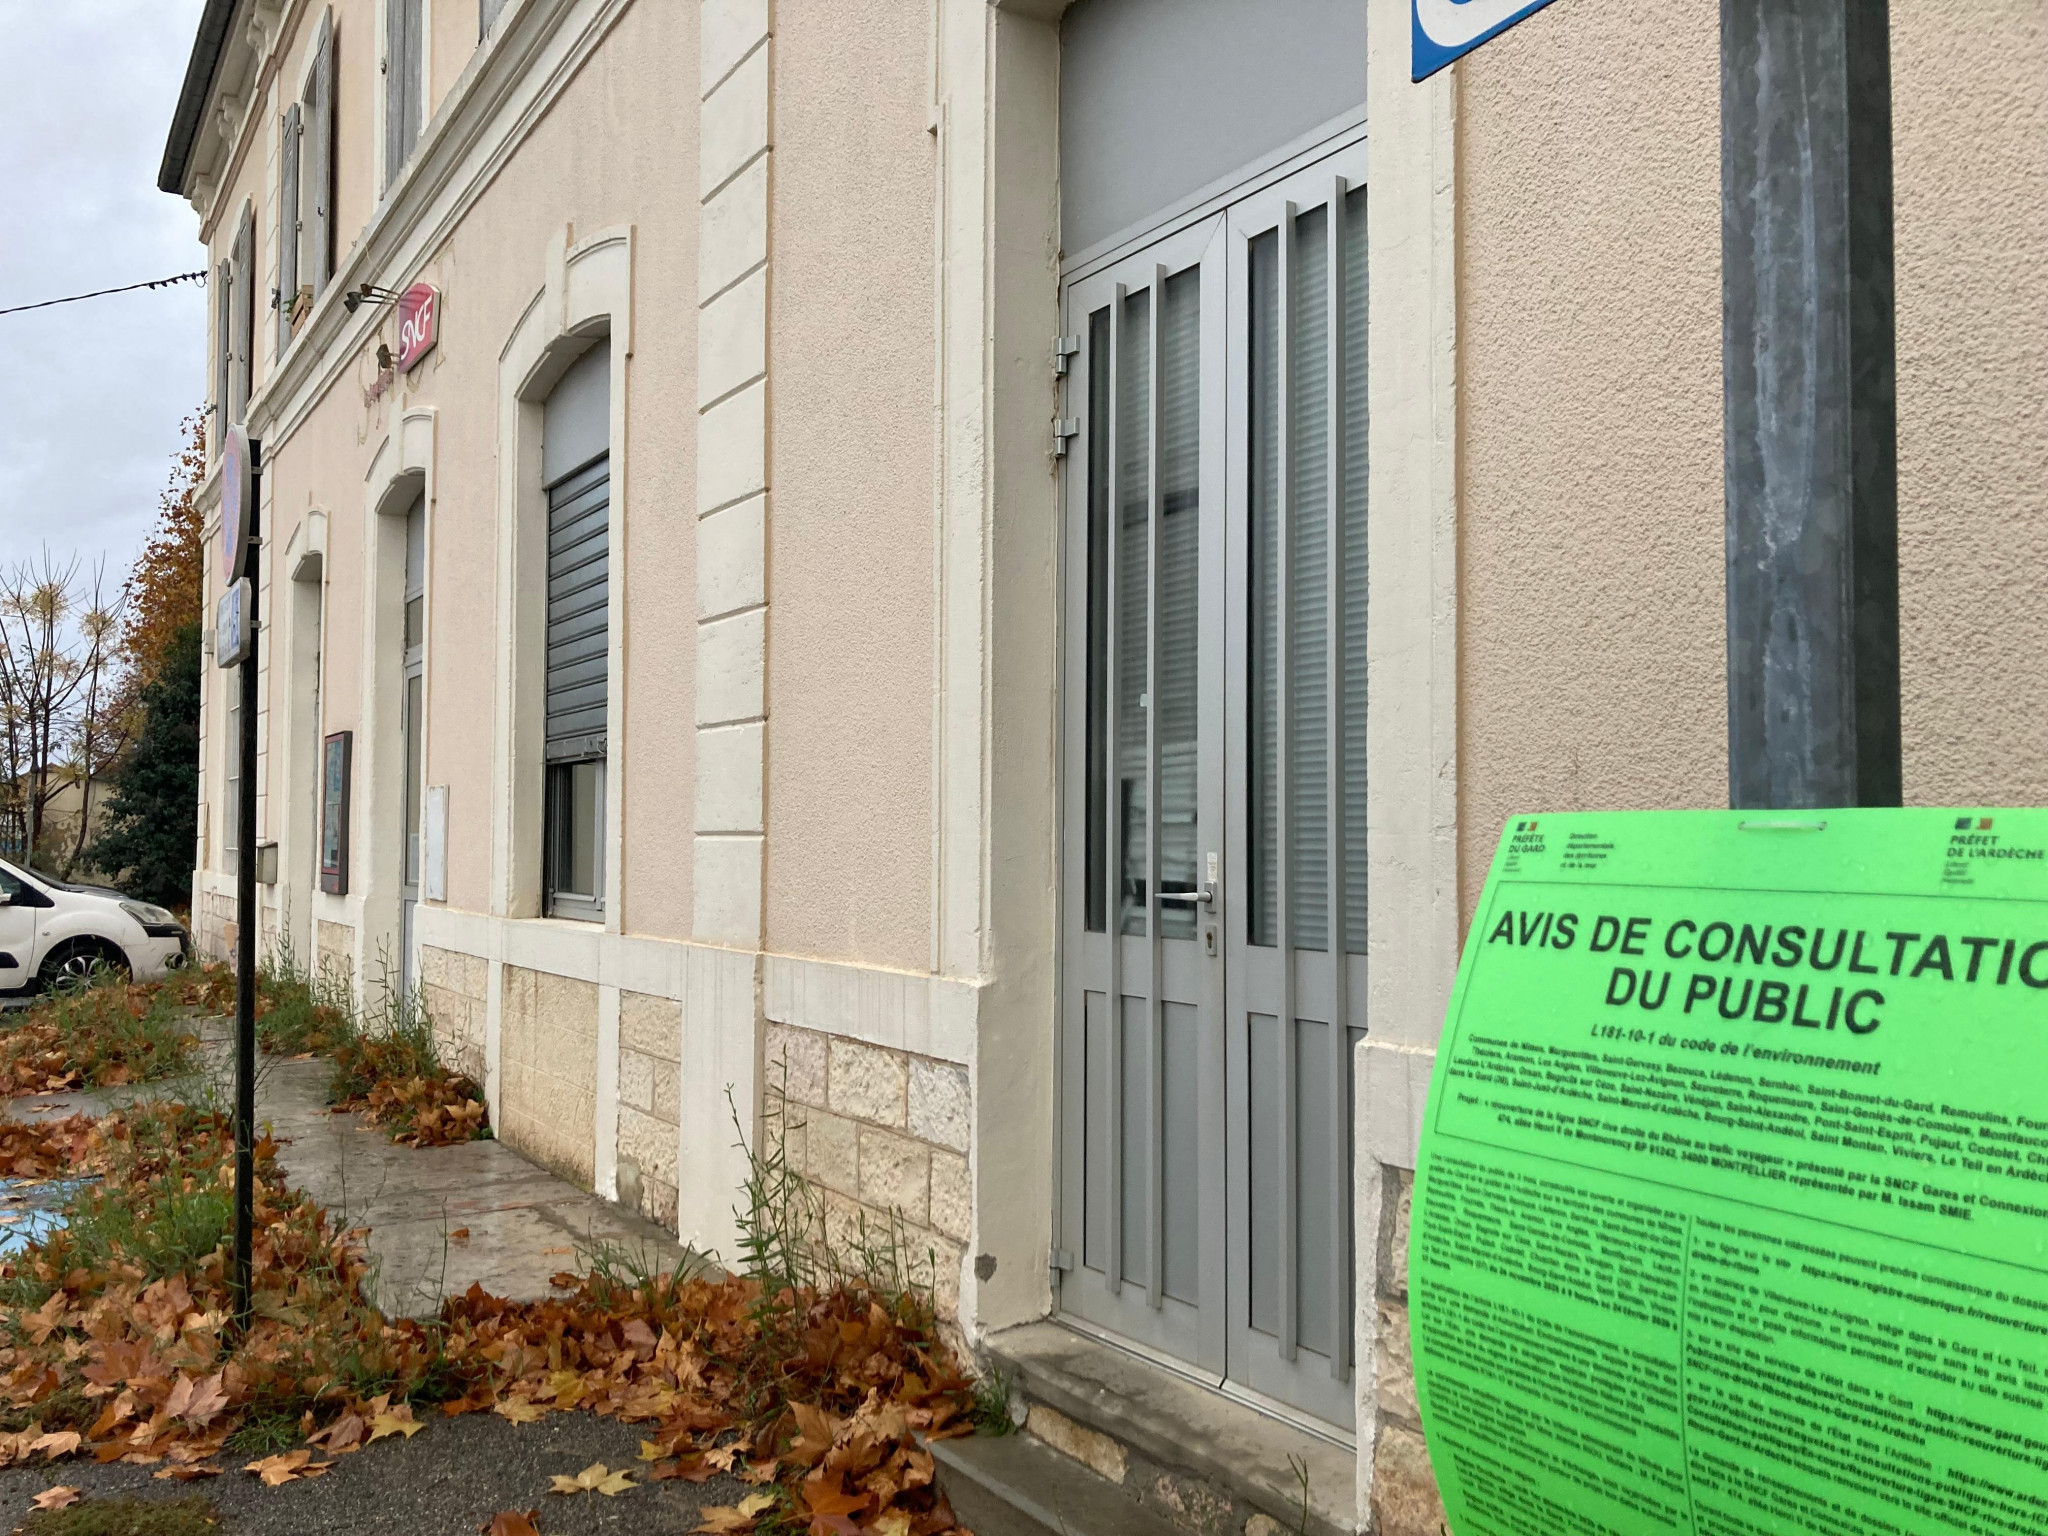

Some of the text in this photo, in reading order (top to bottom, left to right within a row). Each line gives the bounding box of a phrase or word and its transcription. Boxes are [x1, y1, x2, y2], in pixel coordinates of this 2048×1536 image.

[400, 294, 433, 360] SNCF
[1508, 844, 1545, 853] DU GARD
[1947, 847, 1964, 857] DE
[1949, 834, 1999, 846] PRÉFET
[1488, 910, 1578, 950] AVIS
[1590, 915, 1652, 955] DE
[1605, 967, 1885, 1035] DU PUBLIC
[1591, 1023, 1881, 1075] L181-10-1 du code de l'environnement
[1711, 1156, 1786, 1181] MONTPELLIER
[1858, 1188, 1878, 1202] par
[1941, 1153, 1957, 1167] Le
[1961, 1156, 1983, 1172] Teil
[1986, 1163, 2002, 1175] en
[1848, 1169, 1867, 1185] par
[1870, 1173, 1880, 1186] la
[1884, 1176, 1919, 1192] SNCF
[1922, 1184, 1959, 1202] Gares
[1963, 1193, 1976, 1205] et
